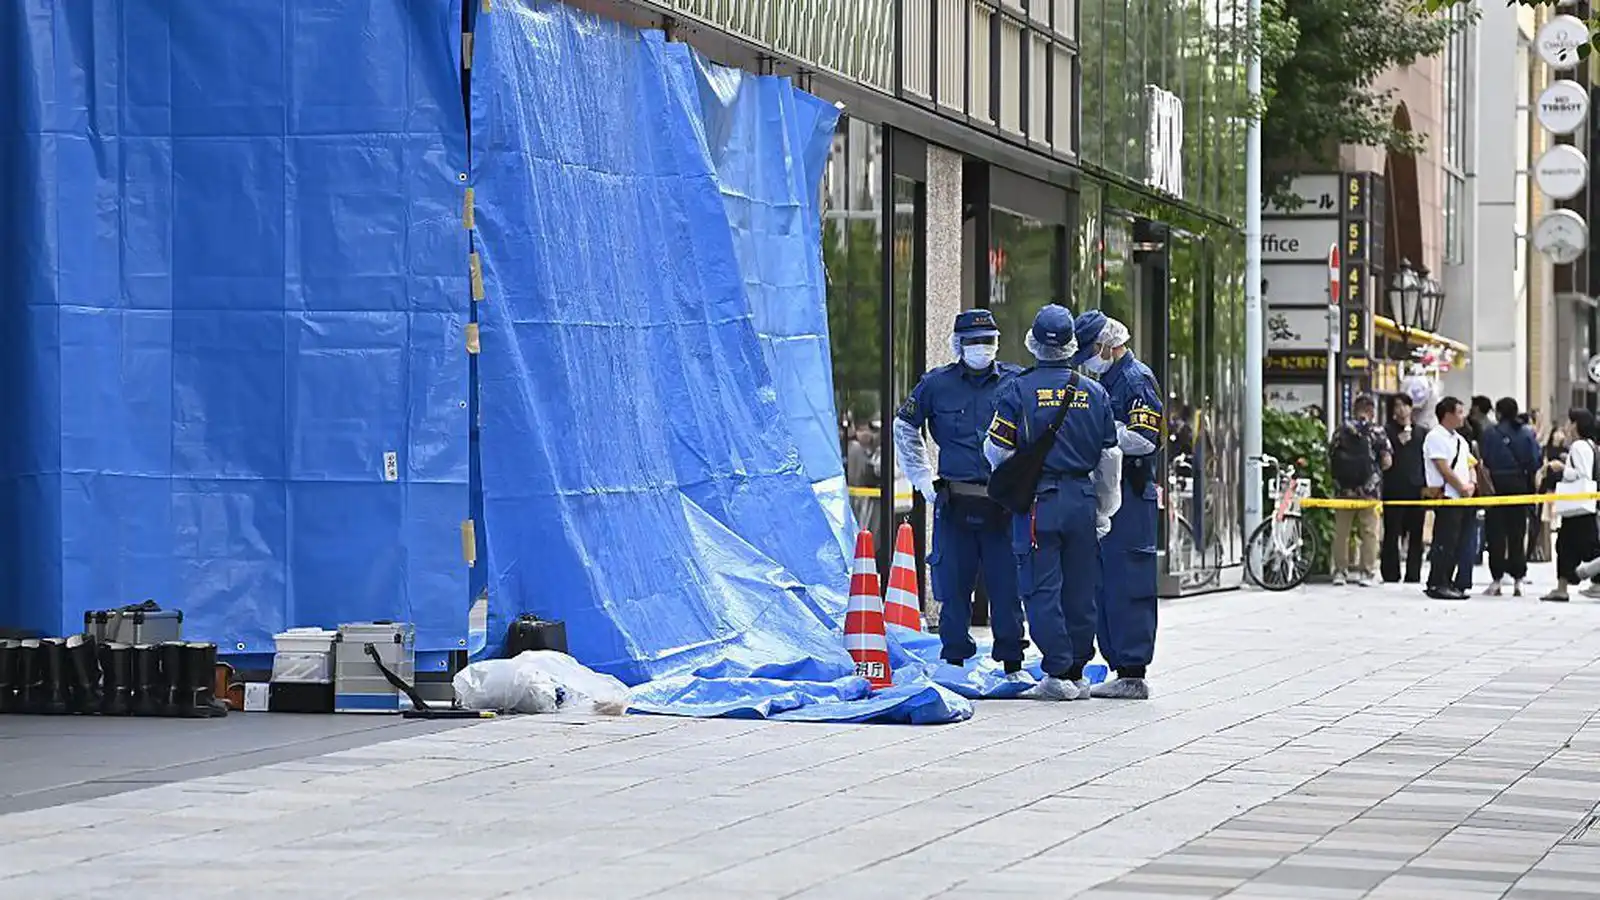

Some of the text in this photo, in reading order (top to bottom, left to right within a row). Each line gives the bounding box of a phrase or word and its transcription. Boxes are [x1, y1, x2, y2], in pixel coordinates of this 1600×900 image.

[1348, 178, 1360, 211] 6F
[1348, 224, 1359, 256] 5F
[1348, 269, 1359, 301] 4F
[1347, 313, 1359, 347] 3F
